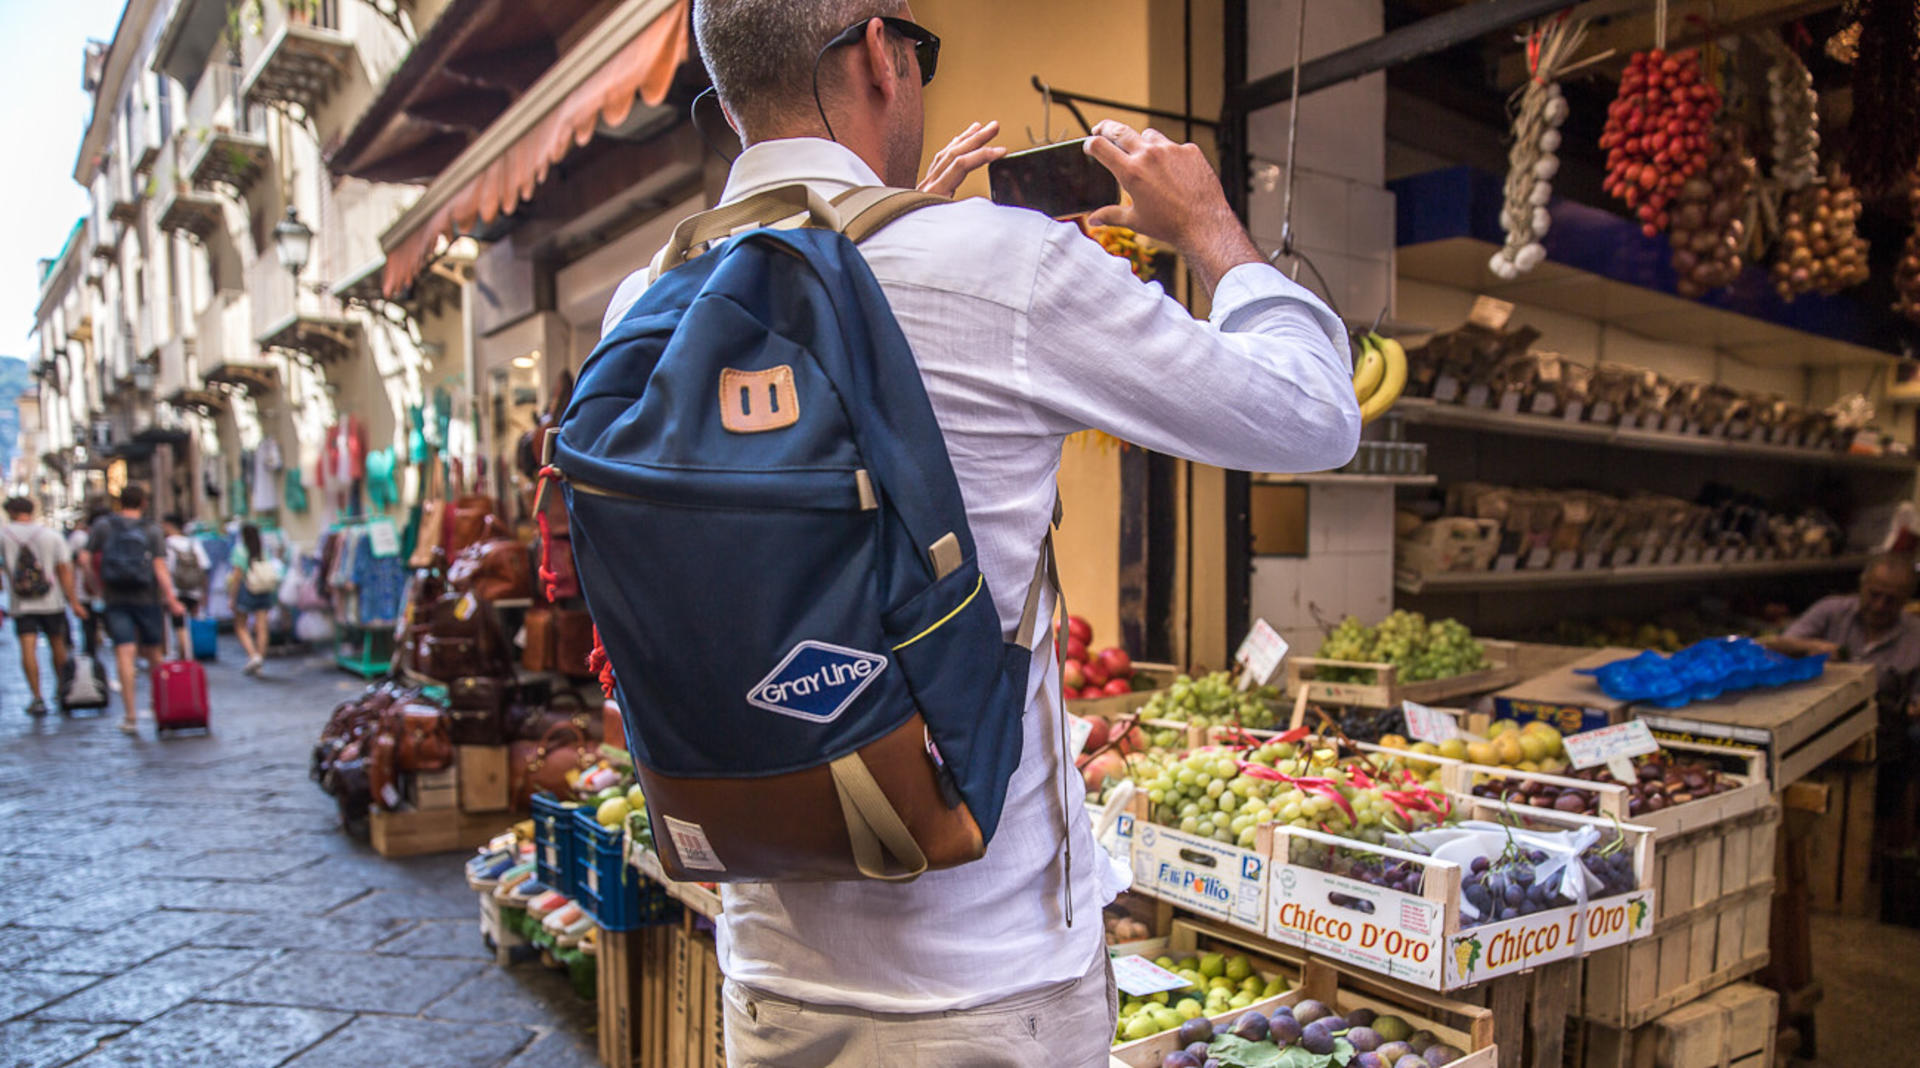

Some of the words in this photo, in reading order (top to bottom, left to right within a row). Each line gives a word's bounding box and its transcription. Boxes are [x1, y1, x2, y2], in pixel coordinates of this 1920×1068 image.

[762, 672, 820, 704] Gray
[820, 659, 872, 686] Line
[1184, 871, 1229, 901] Pollio
[1279, 902, 1352, 942] Chicco
[1360, 923, 1430, 963] D'Oro
[1486, 924, 1560, 969] Chicco
